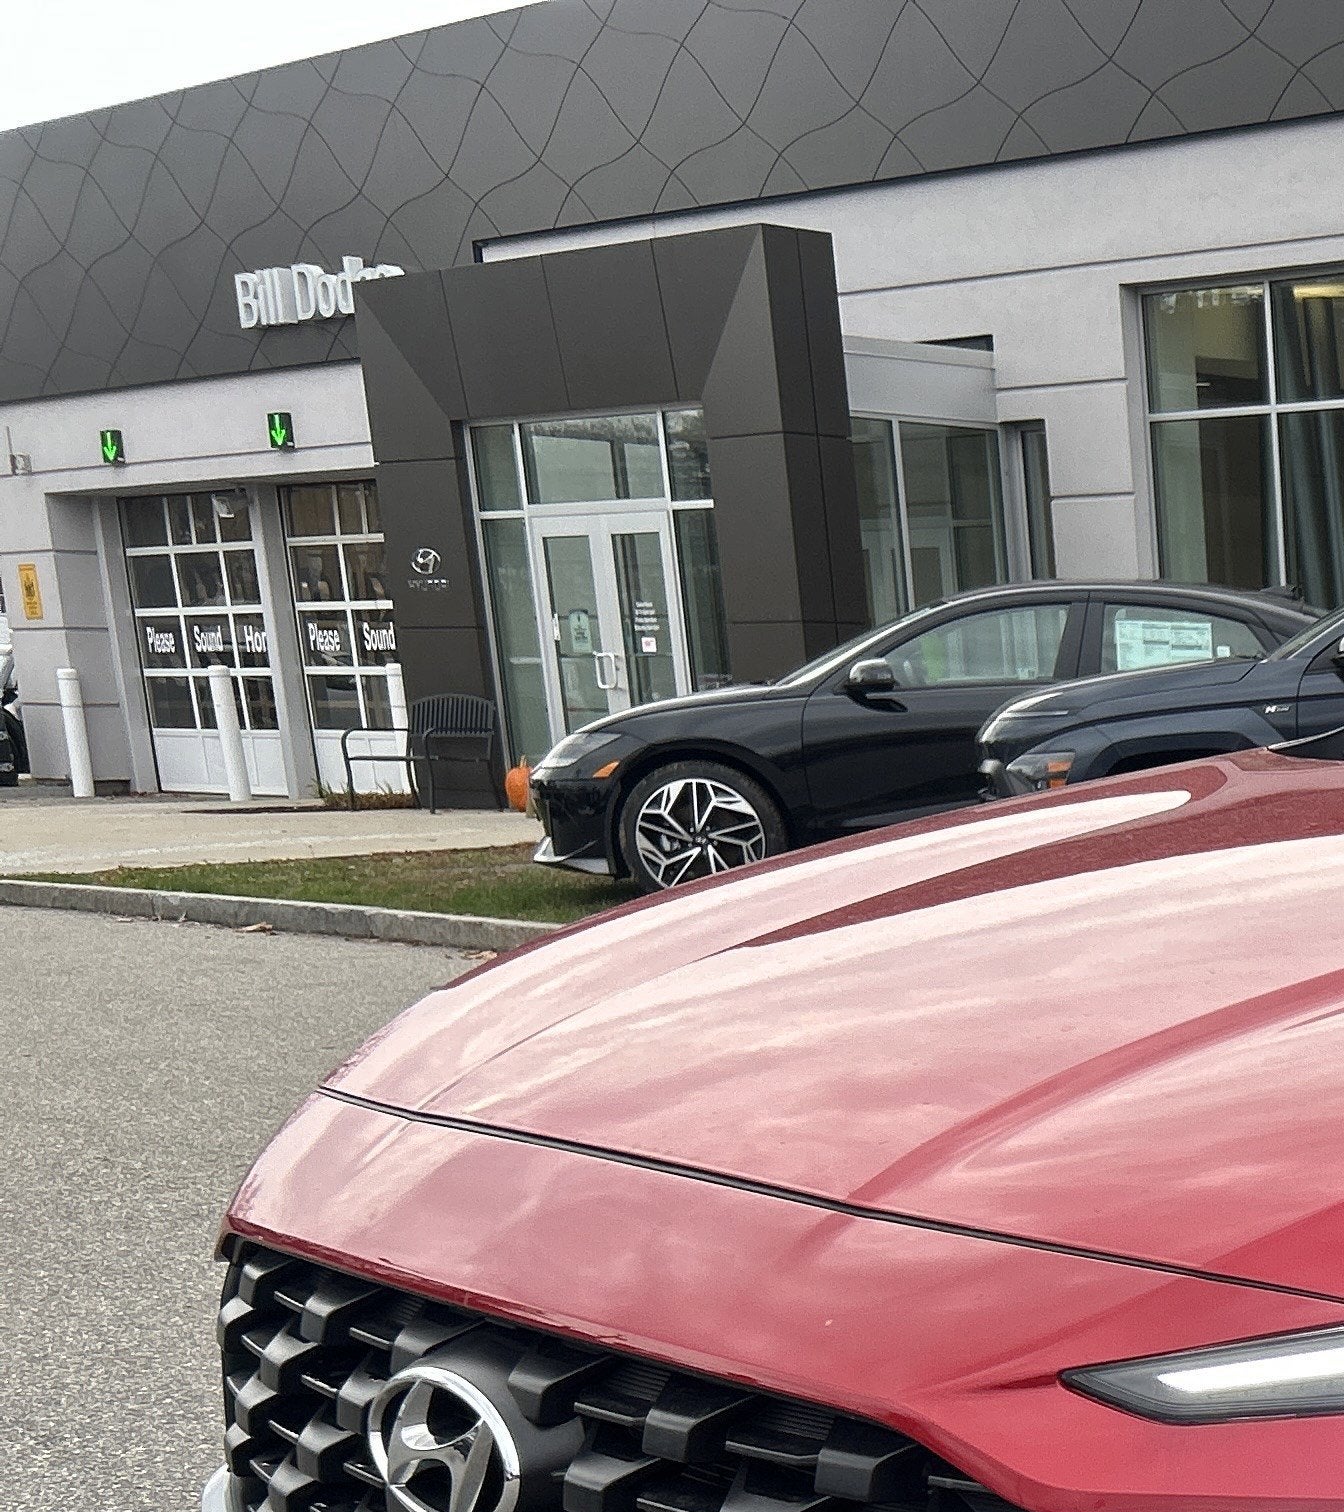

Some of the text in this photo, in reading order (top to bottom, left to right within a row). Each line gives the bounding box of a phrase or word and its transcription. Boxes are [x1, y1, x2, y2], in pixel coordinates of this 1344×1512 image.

[234, 256, 405, 329] Bill Dod
[146, 626, 176, 653] Please
[193, 625, 223, 652] Sound
[308, 621, 396, 651] Please Sound
